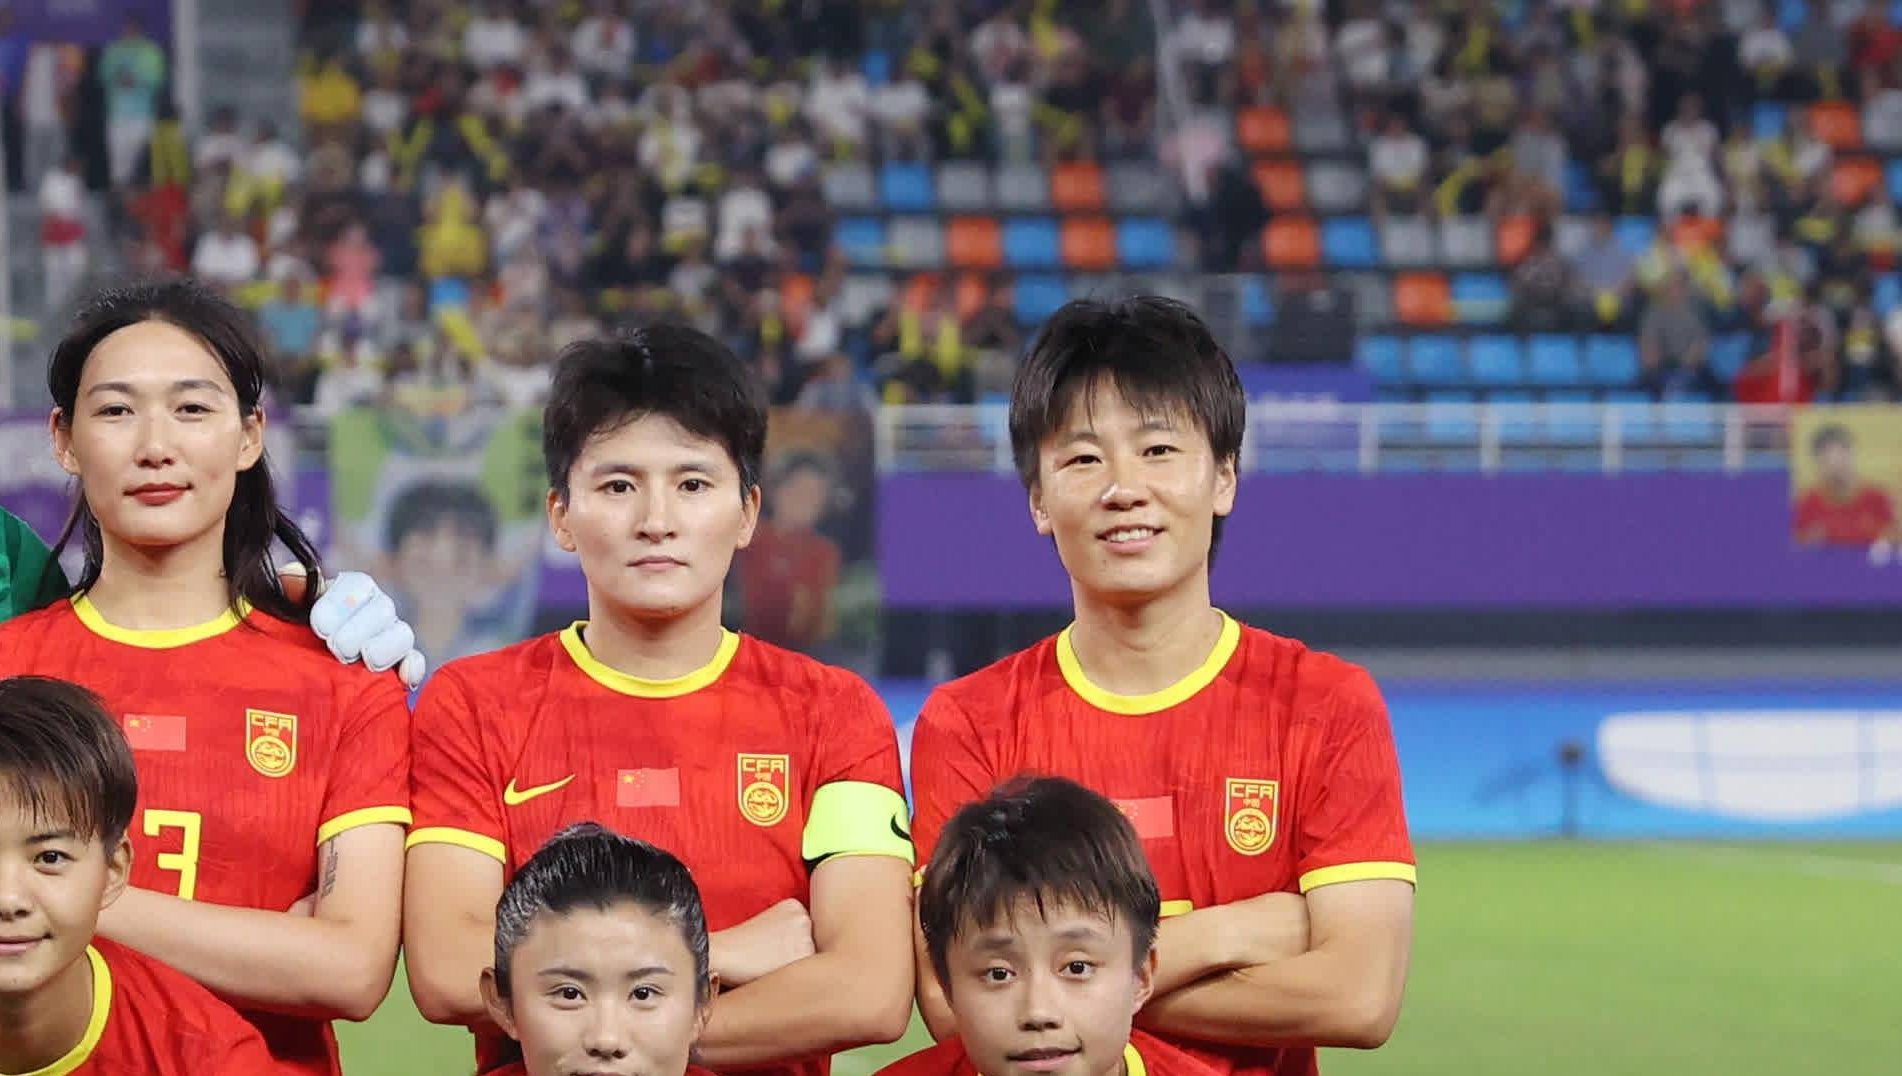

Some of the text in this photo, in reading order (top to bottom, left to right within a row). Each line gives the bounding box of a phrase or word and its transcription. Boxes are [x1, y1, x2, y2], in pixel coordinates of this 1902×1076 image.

[251, 713, 291, 730] CFA
[743, 758, 784, 774] CFA
[1231, 783, 1274, 800] CFA
[144, 810, 201, 902] 3
